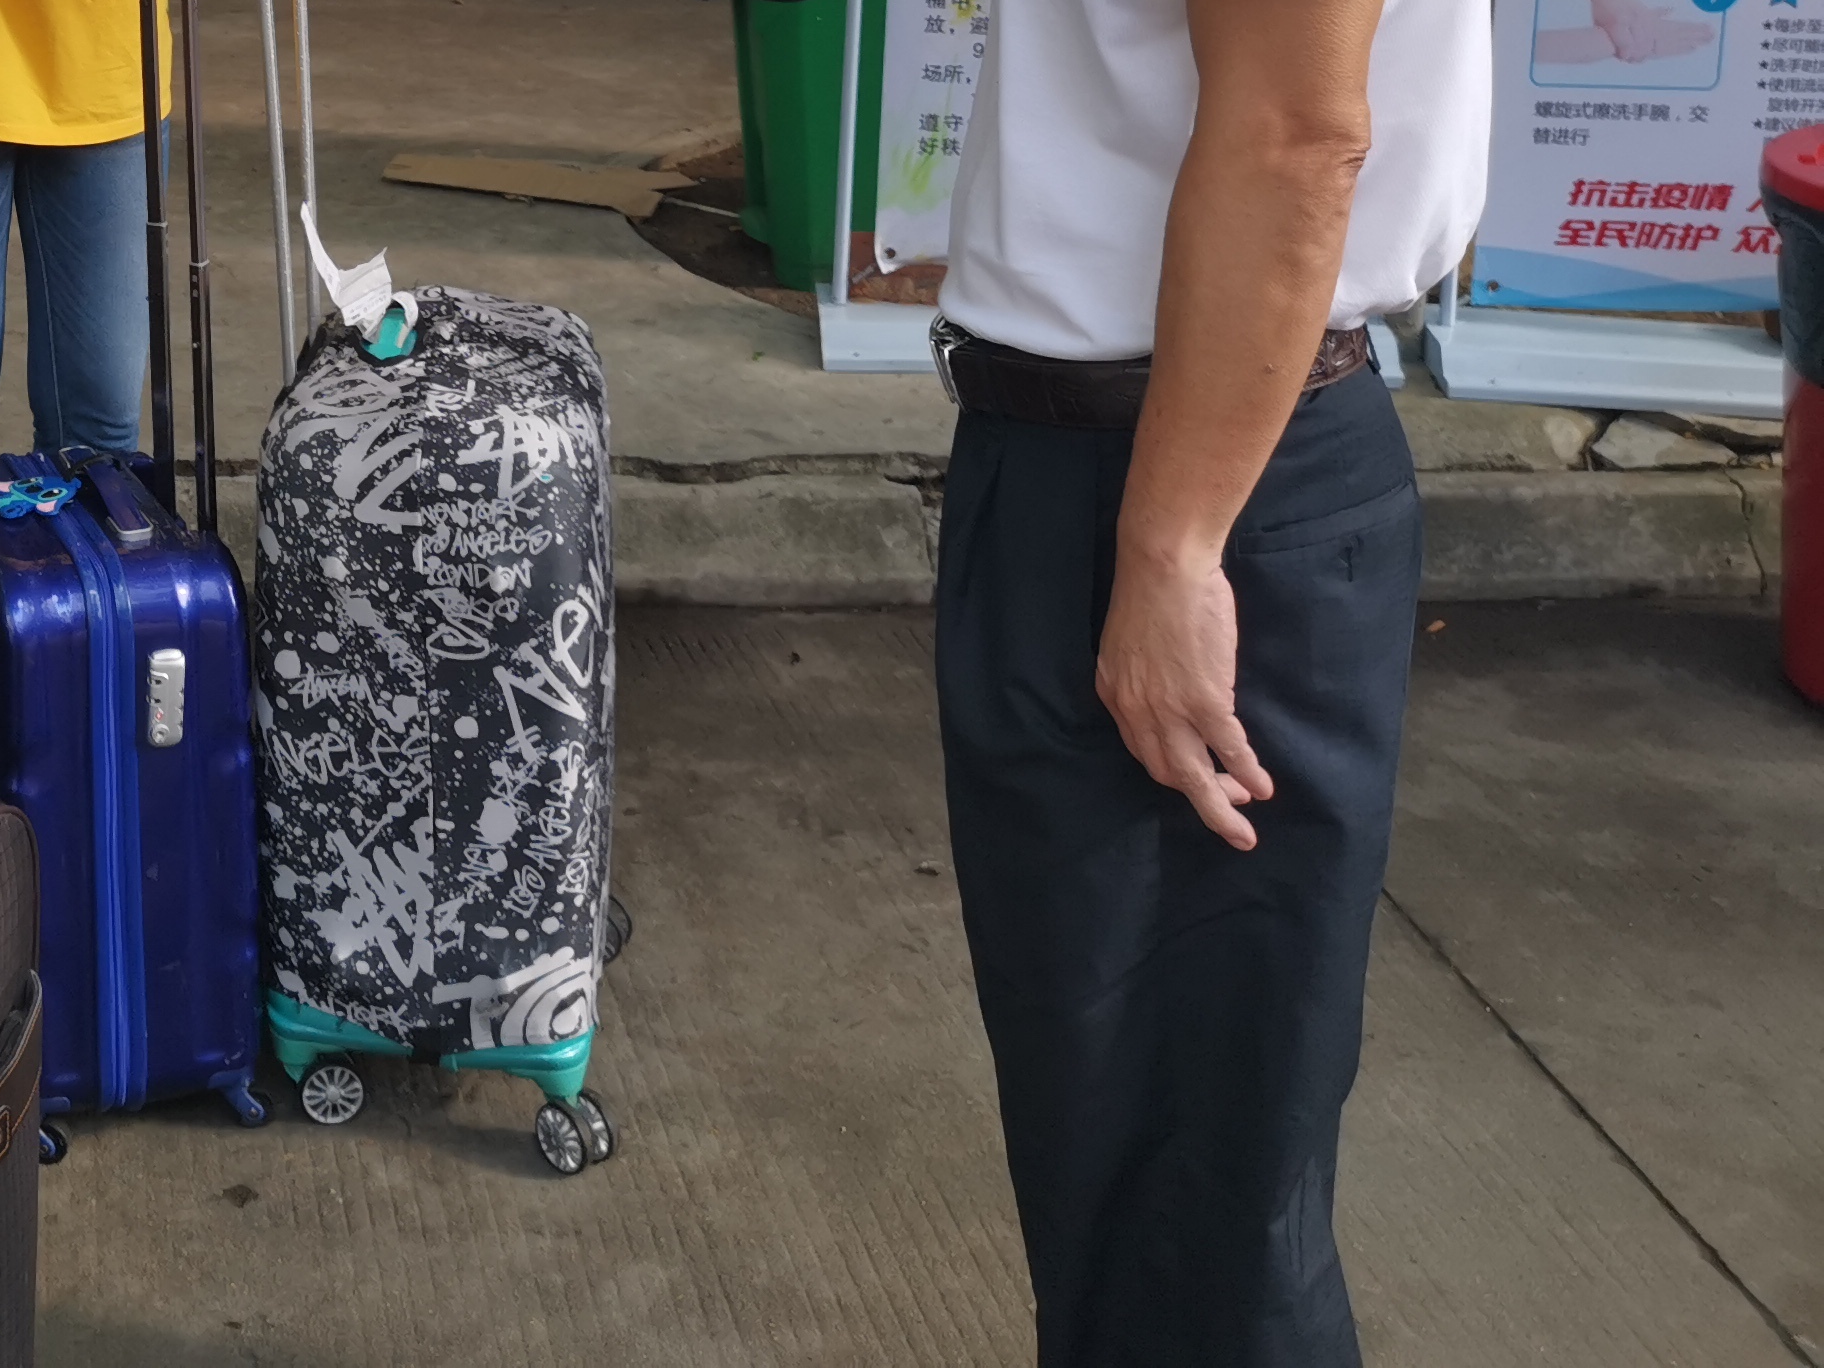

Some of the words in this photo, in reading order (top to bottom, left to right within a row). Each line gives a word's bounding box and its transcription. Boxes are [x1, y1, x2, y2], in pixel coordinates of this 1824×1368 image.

[972, 42, 985, 59] 9
[1567, 178, 1735, 212] 抗击疫情
[1553, 218, 1723, 252] 全民防护
[1732, 225, 1783, 254] 众
